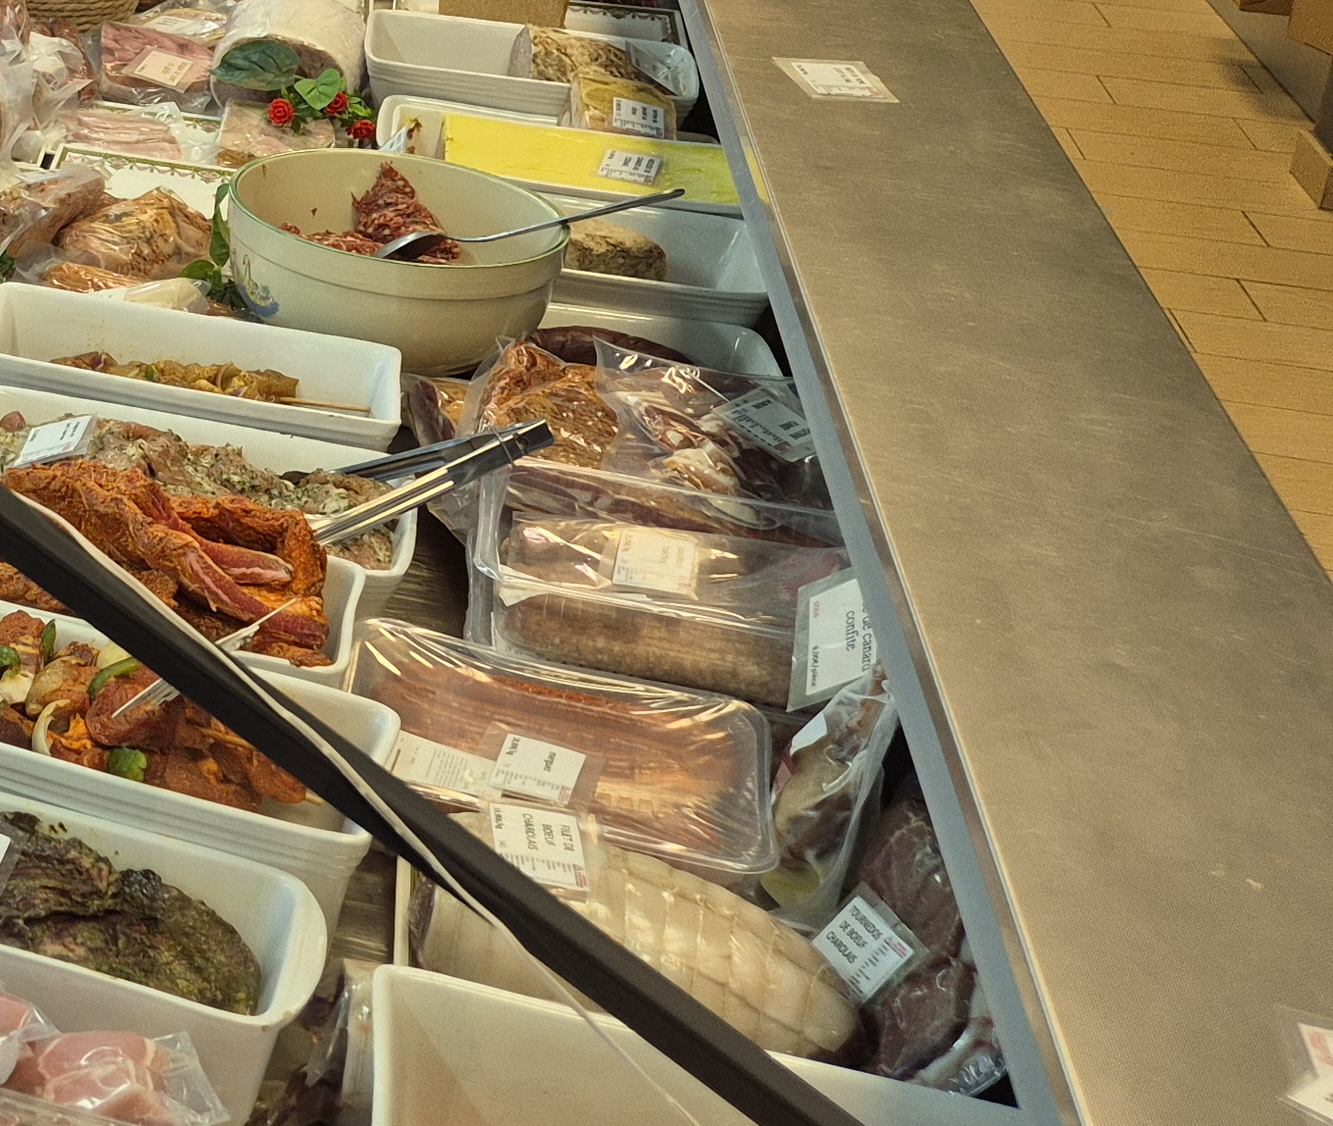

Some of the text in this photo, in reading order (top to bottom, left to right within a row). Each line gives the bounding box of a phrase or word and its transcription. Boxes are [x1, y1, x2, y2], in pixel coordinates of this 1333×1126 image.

[845, 610, 859, 651] confite
[838, 920, 868, 949] DE BOEUF
[848, 905, 883, 940] TOURNEDOS
[825, 931, 858, 964] CHAROLAIS
